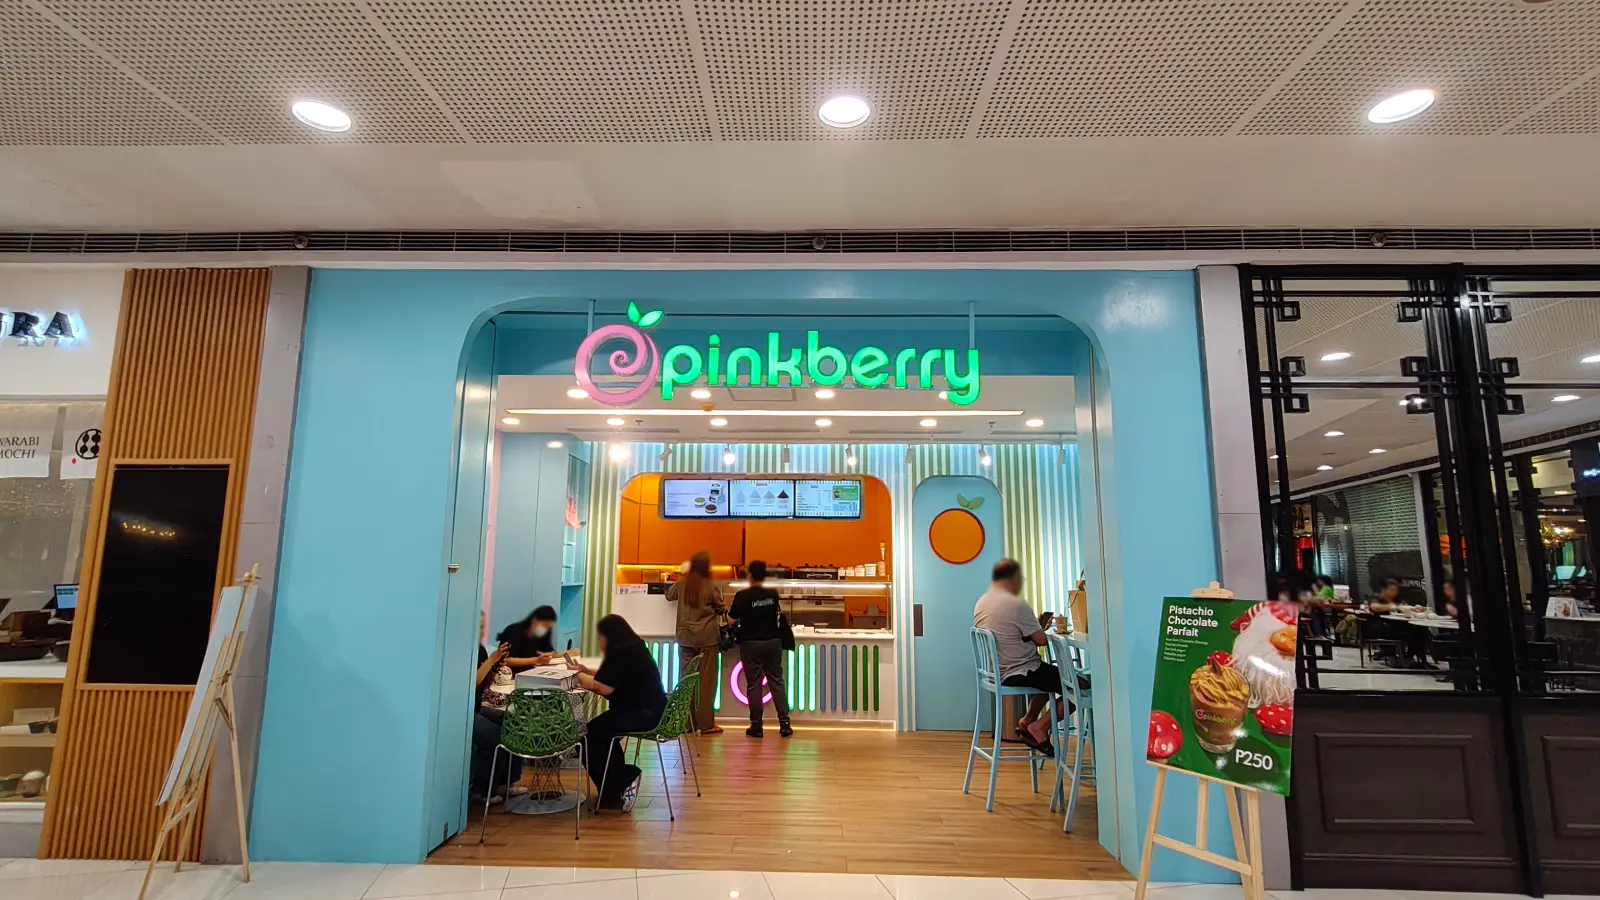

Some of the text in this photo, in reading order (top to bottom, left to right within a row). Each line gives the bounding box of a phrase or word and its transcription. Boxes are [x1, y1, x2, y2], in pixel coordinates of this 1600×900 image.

[661, 330, 981, 406] pinkberry
[1168, 605, 1214, 617] Pistachio
[1167, 615, 1219, 628] Chocolate
[1166, 625, 1199, 637] Parfait
[1235, 748, 1273, 771] P250
